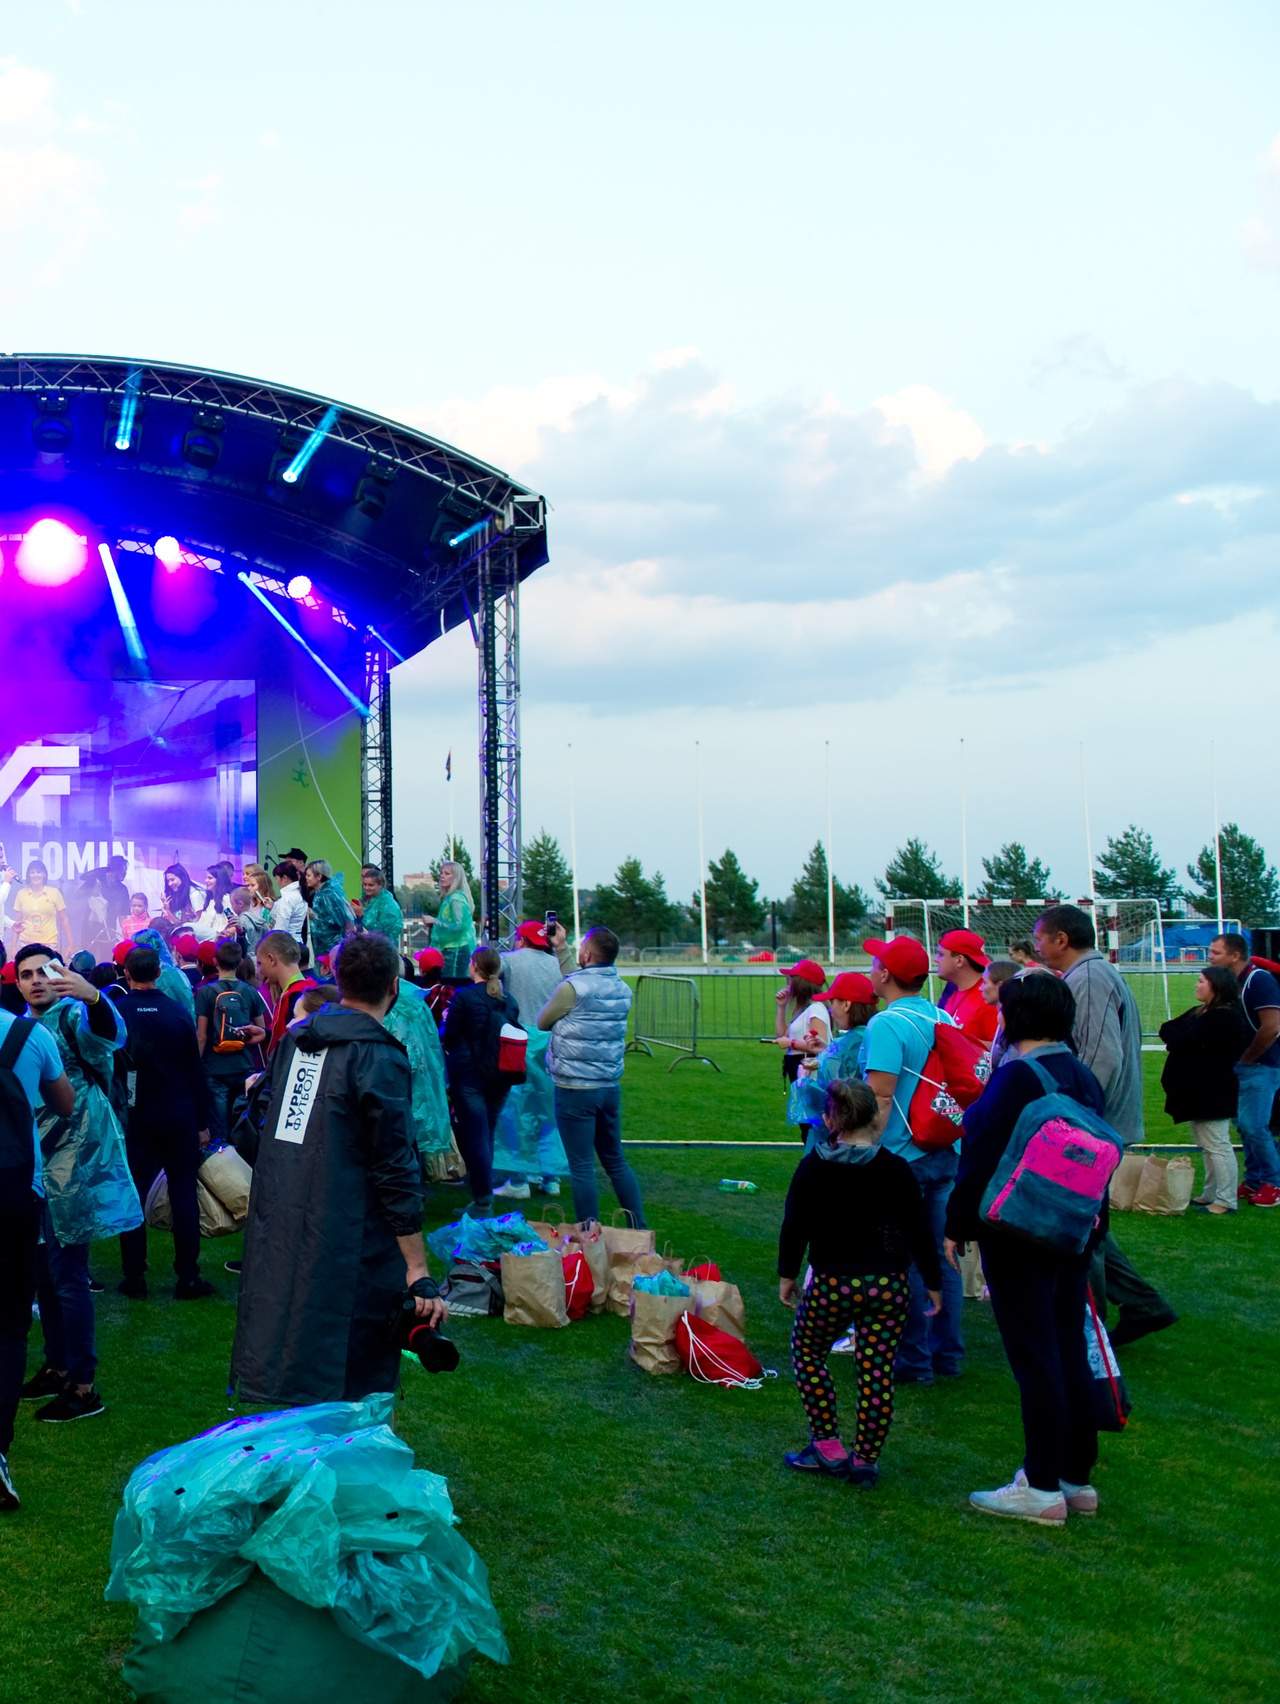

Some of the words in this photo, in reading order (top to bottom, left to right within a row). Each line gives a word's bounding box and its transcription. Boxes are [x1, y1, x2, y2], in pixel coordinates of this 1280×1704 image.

[21, 840, 135, 881] FOMIN
[284, 1067, 307, 1130] ТУРБО
[292, 1068, 318, 1131] ФУТБОЛ
